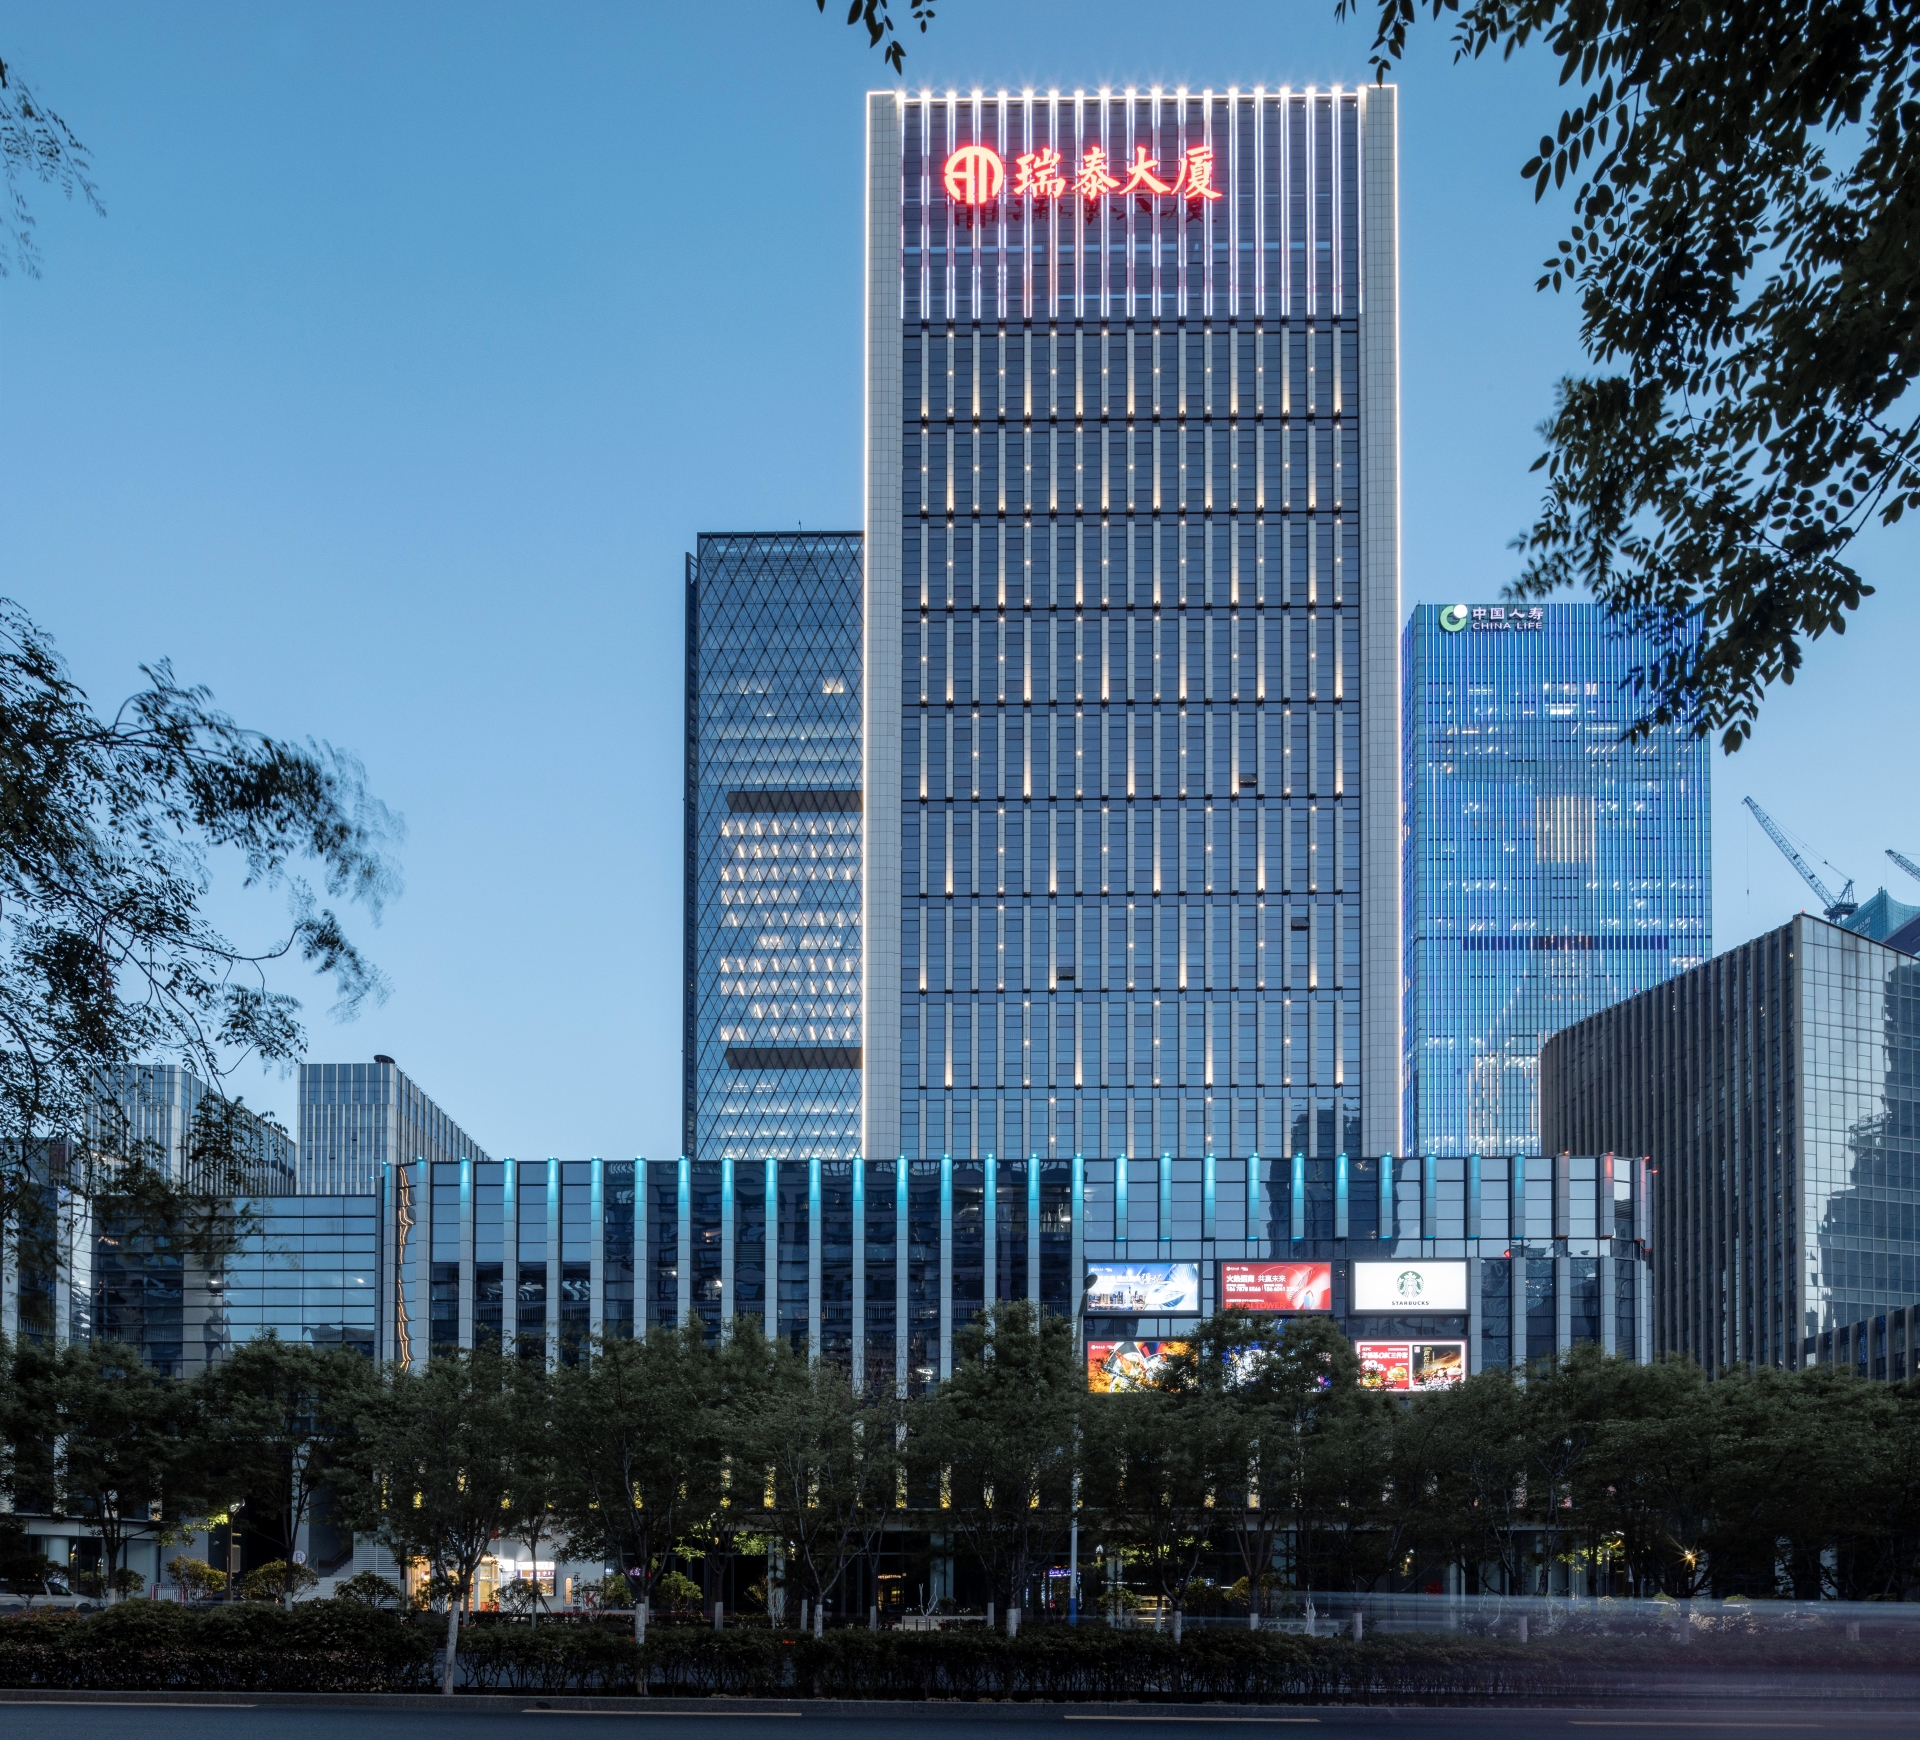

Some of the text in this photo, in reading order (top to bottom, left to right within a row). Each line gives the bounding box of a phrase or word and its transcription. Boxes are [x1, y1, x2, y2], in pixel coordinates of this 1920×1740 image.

[1013, 146, 1223, 200] 瑞泰大厦
[1472, 606, 1544, 620] 中国人寿
[1472, 622, 1543, 630] CHINA LIFE
[1254, 1301, 1286, 1309] TOWER
